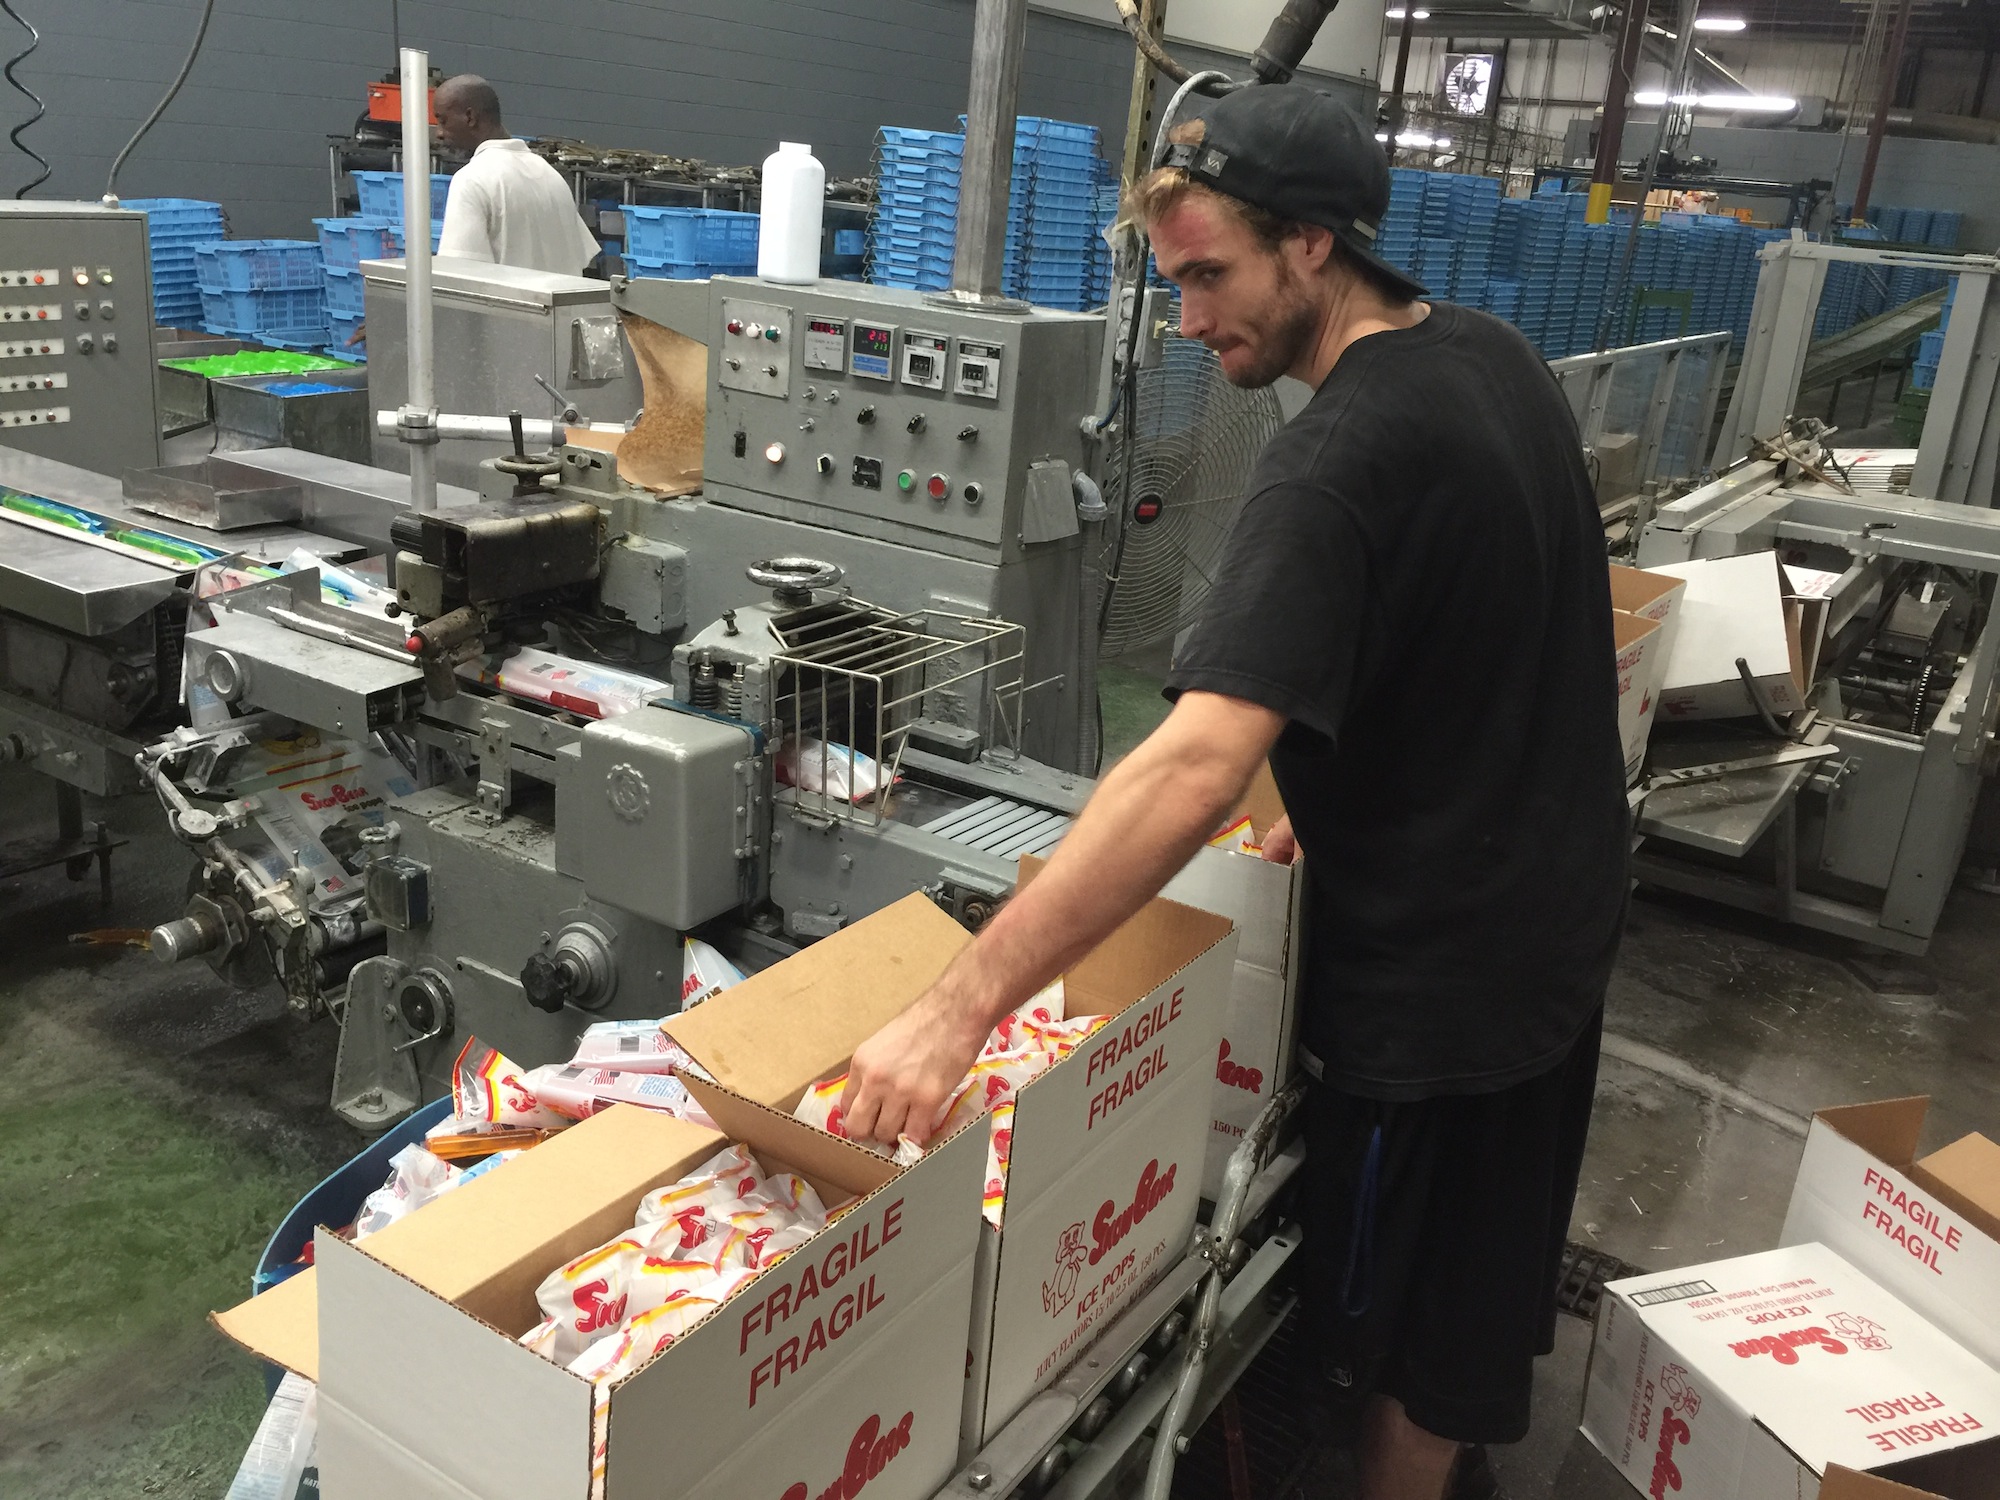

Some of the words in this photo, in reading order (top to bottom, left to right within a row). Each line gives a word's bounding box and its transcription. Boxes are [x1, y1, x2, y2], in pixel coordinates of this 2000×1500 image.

[1085, 986, 1185, 1088] FRAGILE
[1087, 1044, 1169, 1131] FRAGIL
[1213, 1119, 1231, 1134] 150
[1863, 1168, 1963, 1252] FRAGILE
[1862, 1201, 1943, 1275] FRAGIL
[739, 1197, 904, 1356] FRAGILE
[1077, 1284, 1099, 1320] ICE
[1102, 1249, 1136, 1295] POPS
[1746, 1310, 1787, 1325] POPS
[1777, 1292, 1813, 1306] FLAVORS
[1786, 1305, 1812, 1318] ICE
[748, 1274, 885, 1409] FRAGIL
[1059, 1312, 1095, 1356] FLAVORS
[1644, 1379, 1655, 1403] ICE
[1845, 1390, 1945, 1425] FRAGIL
[1638, 1405, 1652, 1443] POPS
[1867, 1411, 1983, 1453] FRAGILE
